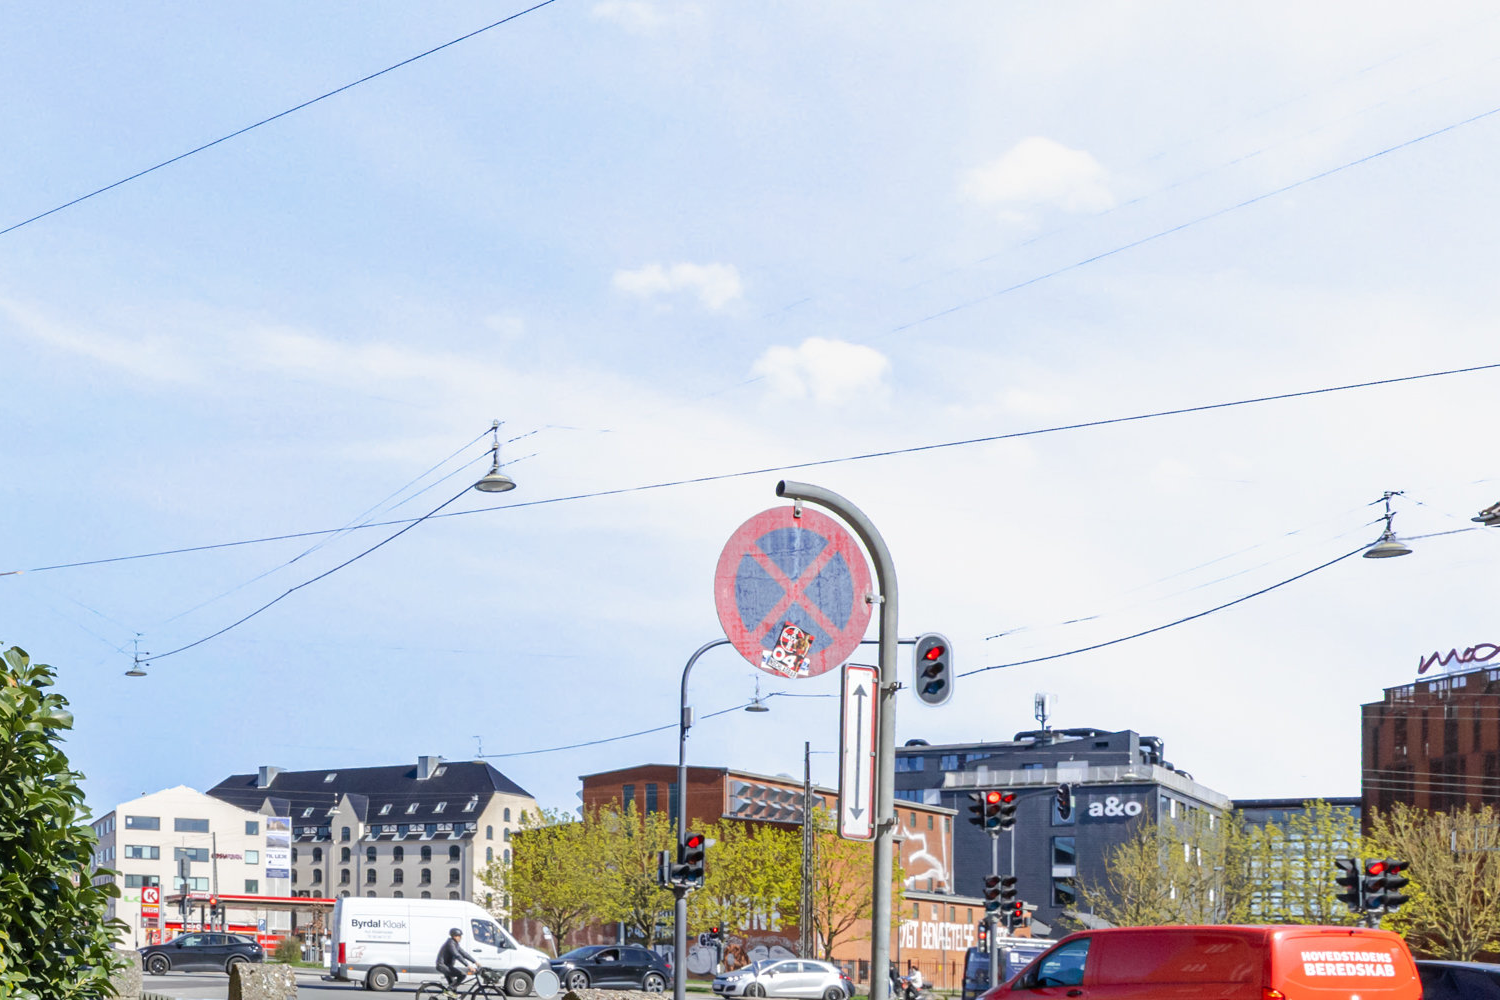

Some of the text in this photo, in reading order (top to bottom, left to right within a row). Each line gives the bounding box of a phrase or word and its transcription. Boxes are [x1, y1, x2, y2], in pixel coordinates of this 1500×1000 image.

[1088, 796, 1142, 817] a&o
[351, 918, 407, 929] Byrdal Kloak
[1301, 951, 1392, 963] HOVEDSTADENS
[1303, 963, 1396, 977] BEREDSKAB
